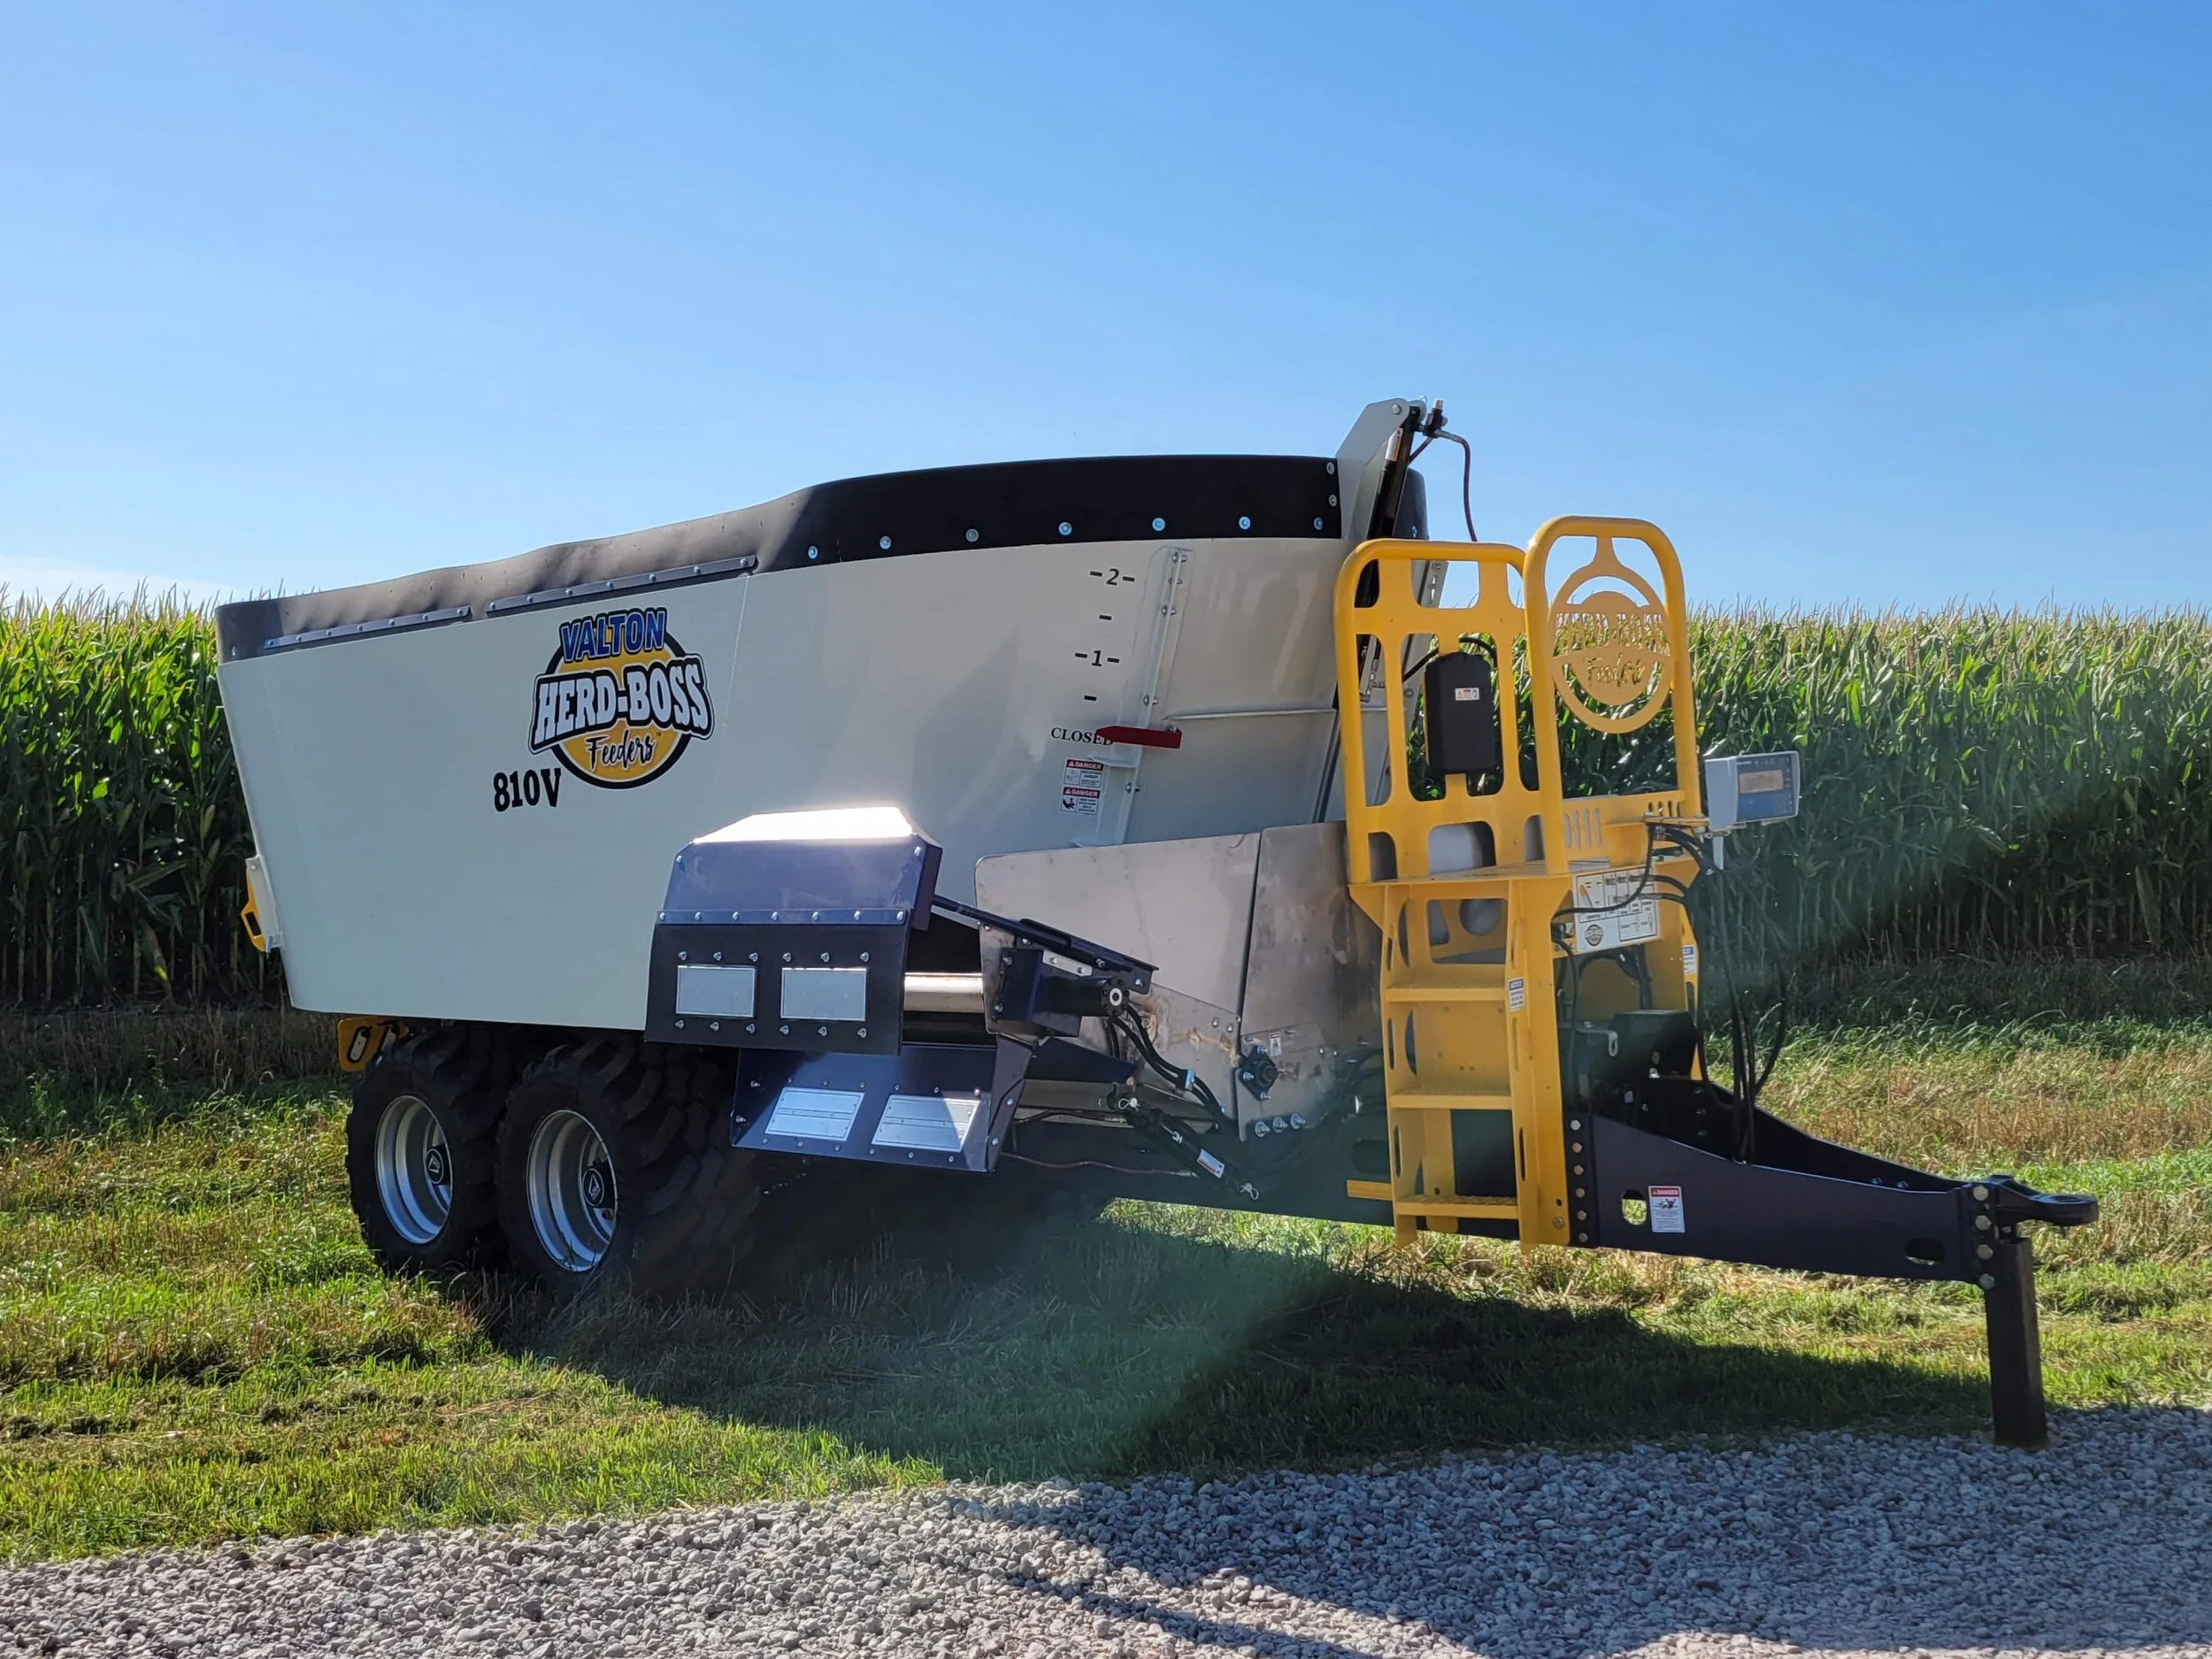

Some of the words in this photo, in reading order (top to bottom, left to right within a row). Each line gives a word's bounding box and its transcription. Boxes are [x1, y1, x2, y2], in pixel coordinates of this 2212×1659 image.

[560, 610, 665, 662] VALTON
[534, 664, 709, 746] HERD-BOSS
[586, 729, 655, 770] Feeders
[493, 767, 562, 812] 810V
